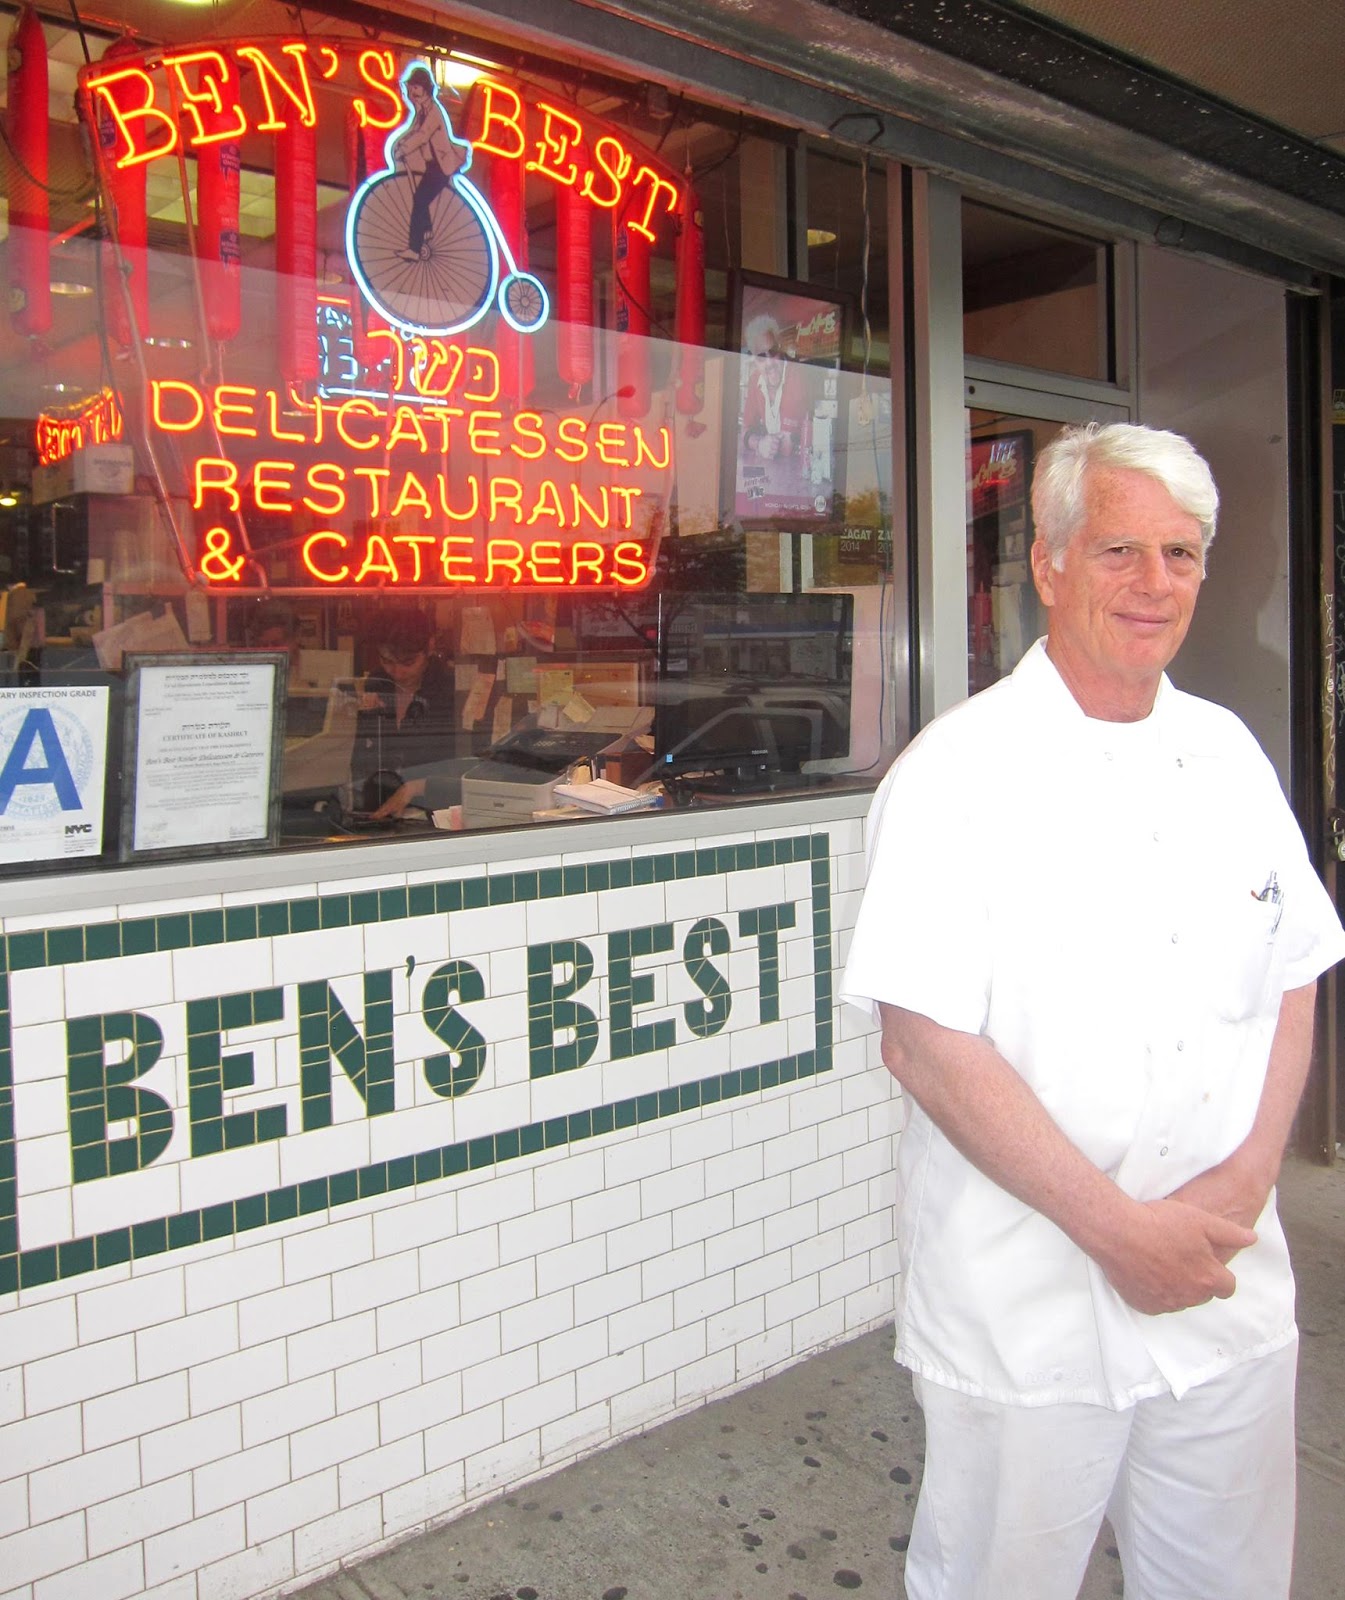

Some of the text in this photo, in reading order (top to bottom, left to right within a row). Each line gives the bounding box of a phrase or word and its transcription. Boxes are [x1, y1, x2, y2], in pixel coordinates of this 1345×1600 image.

[86, 42, 678, 241] BEN'S BEST
[150, 380, 671, 469] DELICATESSEN
[193, 457, 642, 529] RESTAURANT
[199, 526, 648, 586] & CATERERS
[0, 689, 98, 699] ARY INSPECTION GRADE
[0, 707, 83, 816] A
[64, 823, 92, 835] NYC
[65, 901, 796, 1185] BEN'S BEST
